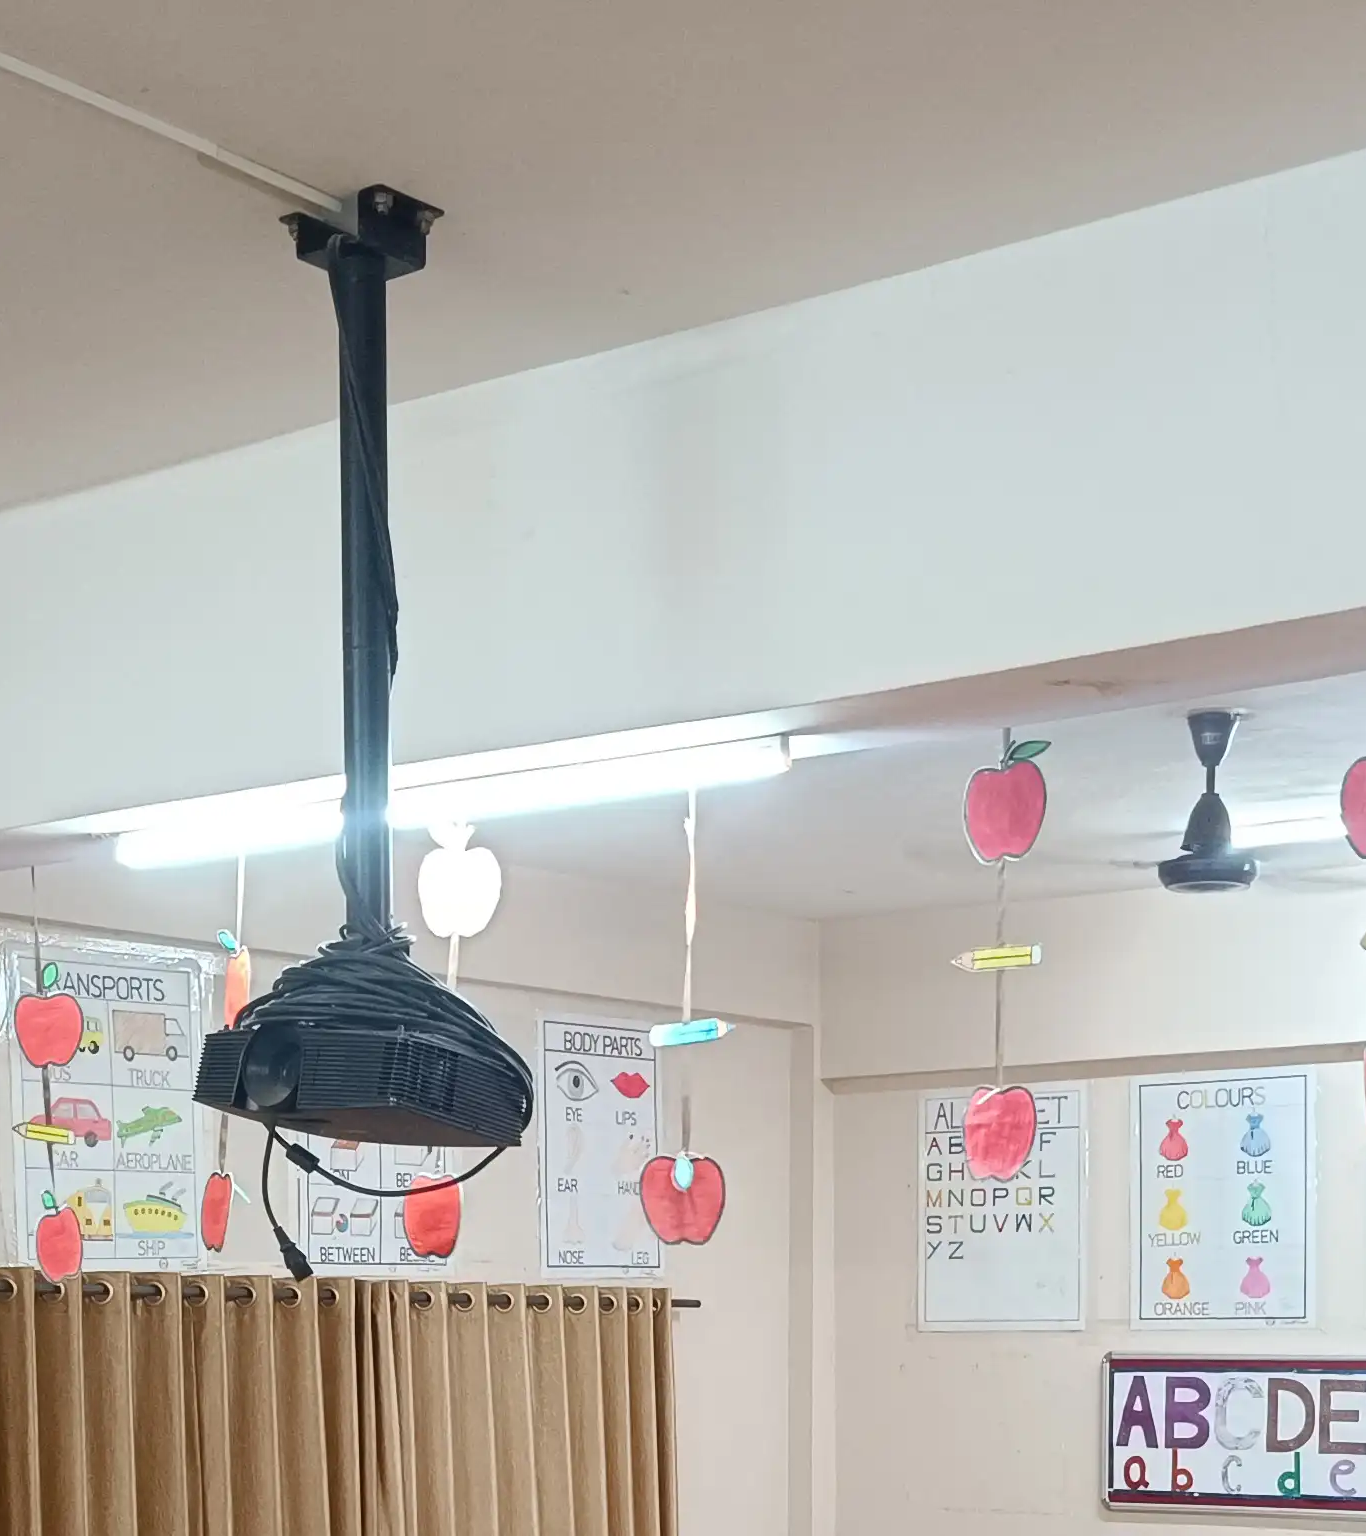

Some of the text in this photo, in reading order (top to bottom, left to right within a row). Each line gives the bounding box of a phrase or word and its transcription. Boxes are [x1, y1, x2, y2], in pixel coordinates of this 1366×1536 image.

[47, 973, 165, 1002] ANSPORTS
[563, 1030, 643, 1057] BODY PARTS
[128, 1068, 172, 1088] TRUCK
[1177, 1086, 1266, 1110] COLOURS
[565, 1107, 583, 1123] EYE
[615, 1110, 637, 1127] LIPS
[116, 1152, 193, 1171] AEROPLANE
[1236, 1159, 1273, 1175] BLUE
[1156, 1164, 1184, 1179] RED
[557, 1177, 579, 1194] EAR
[1148, 1231, 1202, 1247] YELLOW
[1233, 1229, 1279, 1244] GREEN
[137, 1240, 166, 1257] SHIP
[320, 1246, 376, 1264] BETWEEN
[558, 1250, 585, 1266] NOSE
[631, 1251, 650, 1266] LEG
[1154, 1301, 1210, 1316] ORANGE
[1234, 1301, 1267, 1316] PINK
